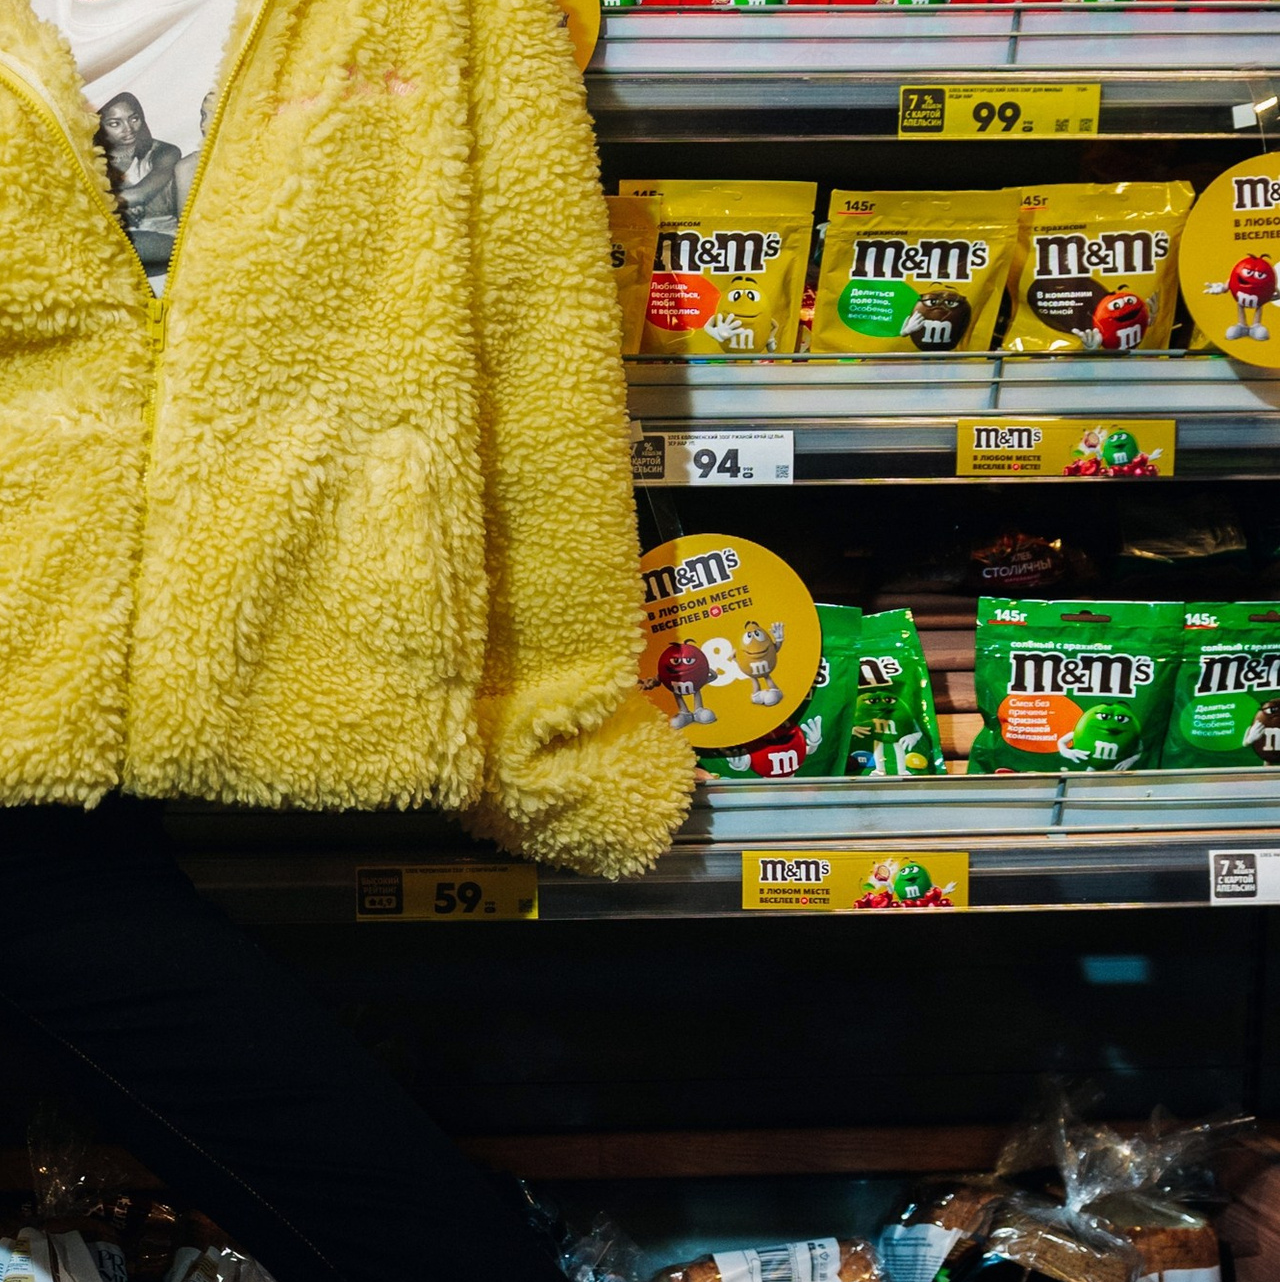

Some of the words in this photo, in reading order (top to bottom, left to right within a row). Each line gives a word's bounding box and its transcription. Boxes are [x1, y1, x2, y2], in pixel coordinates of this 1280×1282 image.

[908, 94, 917, 109] 7
[902, 118, 942, 128] АПЕЛЬСИН
[912, 109, 941, 119] КАРТОЙ
[972, 102, 1021, 132] 99
[845, 201, 876, 212] 145г
[850, 238, 988, 282] m&m's
[1034, 231, 1170, 279] m&m's
[974, 426, 1041, 449] m&m's
[693, 448, 741, 479] 94
[642, 548, 738, 603] m&m's
[982, 559, 1052, 579] СТОЛИЧНЫ
[659, 598, 707, 618] ЛЮБОМ
[710, 585, 749, 603] МЕСТЕ
[651, 613, 701, 633] ВЕСЕЛЕЕ
[995, 609, 1027, 622] 145г
[1185, 613, 1217, 625] 145г
[1008, 651, 1154, 697] m&m's
[759, 857, 830, 883] m&m's
[1220, 860, 1229, 874] 7
[361, 876, 399, 886] ВЫСОКИЙ
[1216, 883, 1256, 893] АПЕЛЬСИН
[1225, 874, 1254, 884] КАРТОЙ
[363, 886, 397, 895] РЕЙТИНГ
[434, 882, 482, 914] 59
